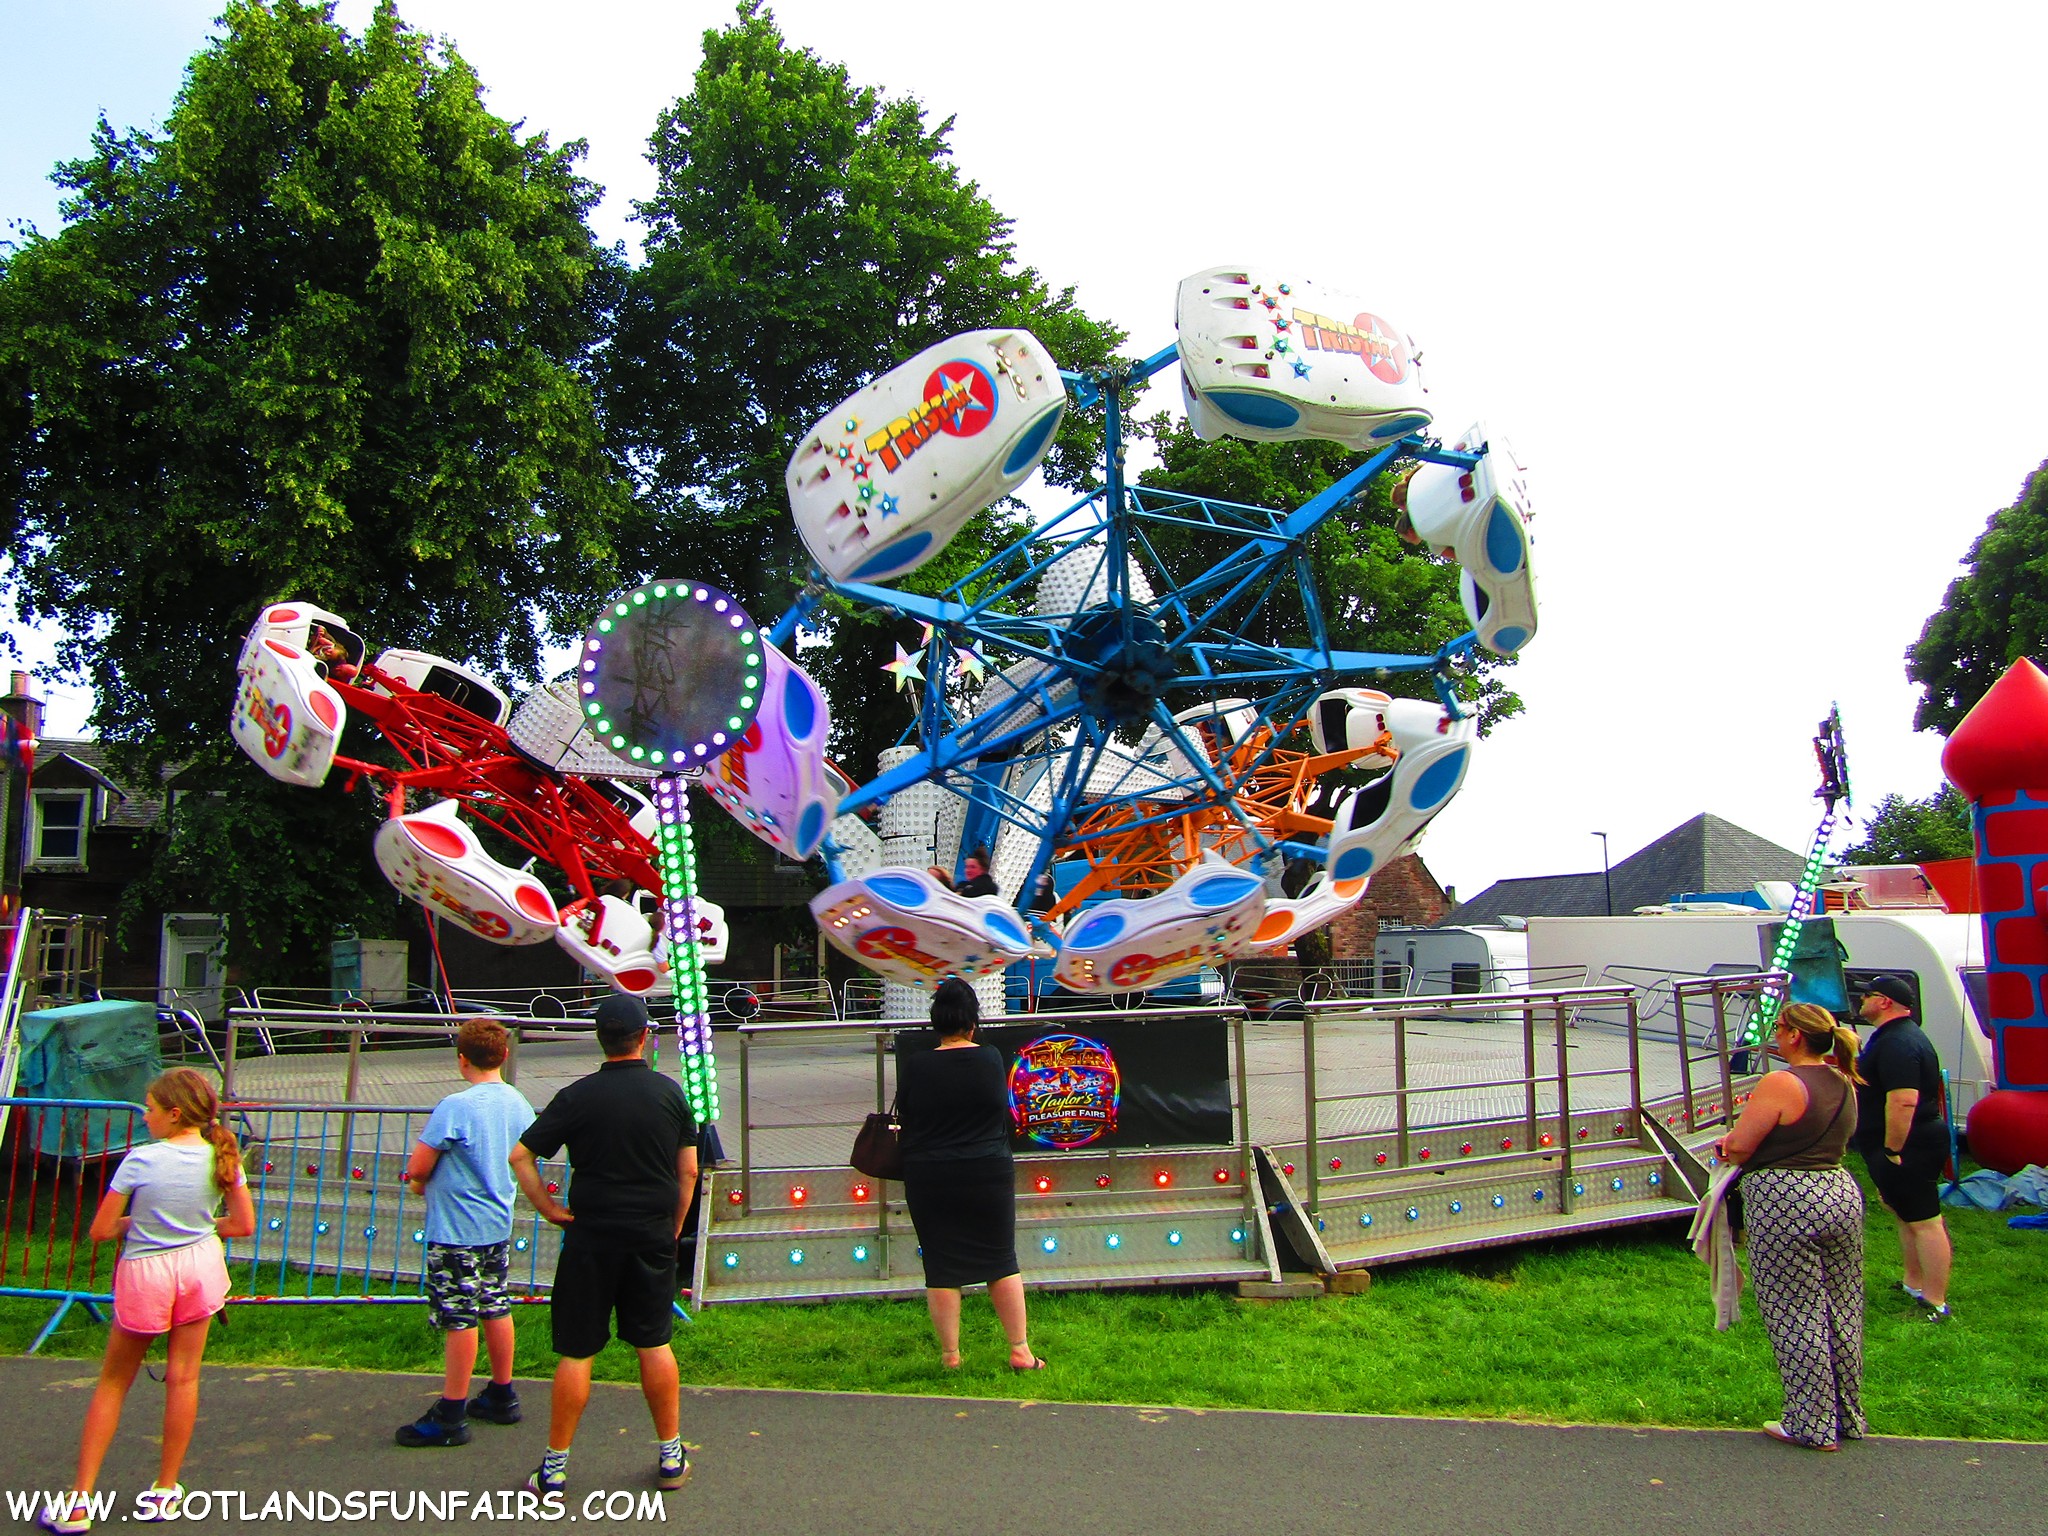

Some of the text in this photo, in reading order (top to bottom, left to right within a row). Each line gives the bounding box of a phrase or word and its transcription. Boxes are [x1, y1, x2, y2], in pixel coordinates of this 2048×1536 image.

[1292, 307, 1392, 356] TRISTAR
[864, 381, 973, 474] TRISTAR
[1028, 1109, 1106, 1122] PLEASURE FAIRS
[1035, 1090, 1094, 1114] Taylor's
